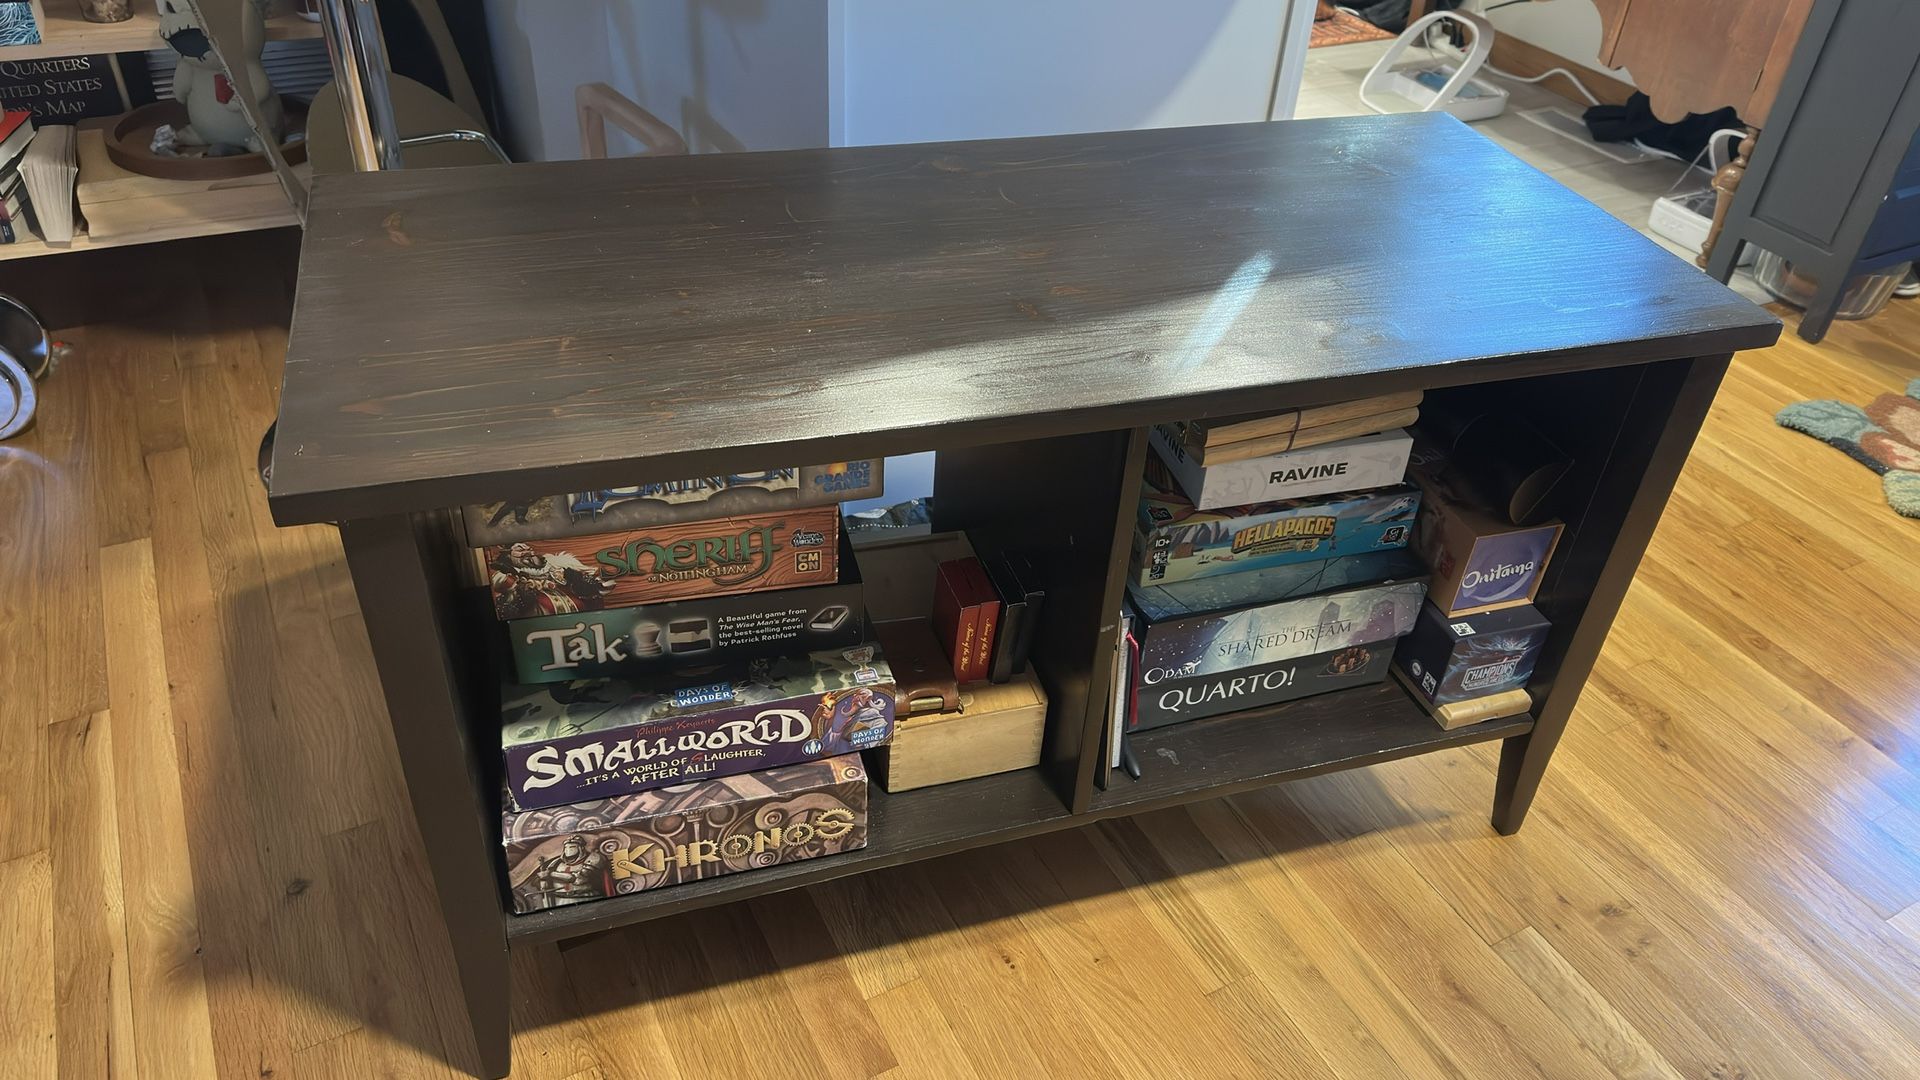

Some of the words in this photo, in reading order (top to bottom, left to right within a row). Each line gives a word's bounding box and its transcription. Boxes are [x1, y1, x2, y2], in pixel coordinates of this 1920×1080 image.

[0, 57, 91, 80] QUARTERS
[0, 84, 41, 99] ITED
[44, 78, 103, 95] STATES
[46, 100, 86, 116] MAP
[815, 469, 871, 484] GRANDE
[1269, 462, 1349, 484] RAVINE
[823, 479, 871, 493] GAMES
[1235, 515, 1337, 550] HELLAPAGOS
[1155, 538, 1171, 548] 10+
[658, 564, 749, 583] NOTTINGHAM
[1461, 560, 1534, 588] Onitama
[726, 612, 763, 622] Beautiful
[765, 610, 787, 620] game
[788, 608, 807, 616] from
[718, 631, 733, 639] the
[734, 625, 781, 637] best-selling
[783, 622, 804, 631] novel
[719, 623, 734, 631] The
[736, 621, 755, 629] Wise
[757, 618, 780, 627] Man's
[1282, 626, 1297, 634] THE
[526, 622, 628, 671] Tak
[718, 639, 729, 648] by
[731, 635, 760, 645] Patrick
[762, 631, 797, 642] Rothfuss
[1218, 633, 1288, 659] SHARED
[1292, 621, 1351, 646] DREAM
[1144, 664, 1197, 686] ODAM
[1465, 662, 1516, 684] CHAMPIONS
[678, 688, 709, 698] DAYS
[712, 684, 728, 692] OF
[679, 691, 731, 706] WONDER
[1158, 667, 1296, 712] QUARTO!
[635, 725, 673, 739] Philippe
[852, 734, 884, 745] WONDER
[853, 730, 873, 739] DAYS
[623, 760, 668, 776] WORLD
[671, 757, 688, 766] OF
[630, 767, 680, 785] AFTER
[684, 762, 716, 775] ALL!
[610, 808, 856, 880] KHRONOS
